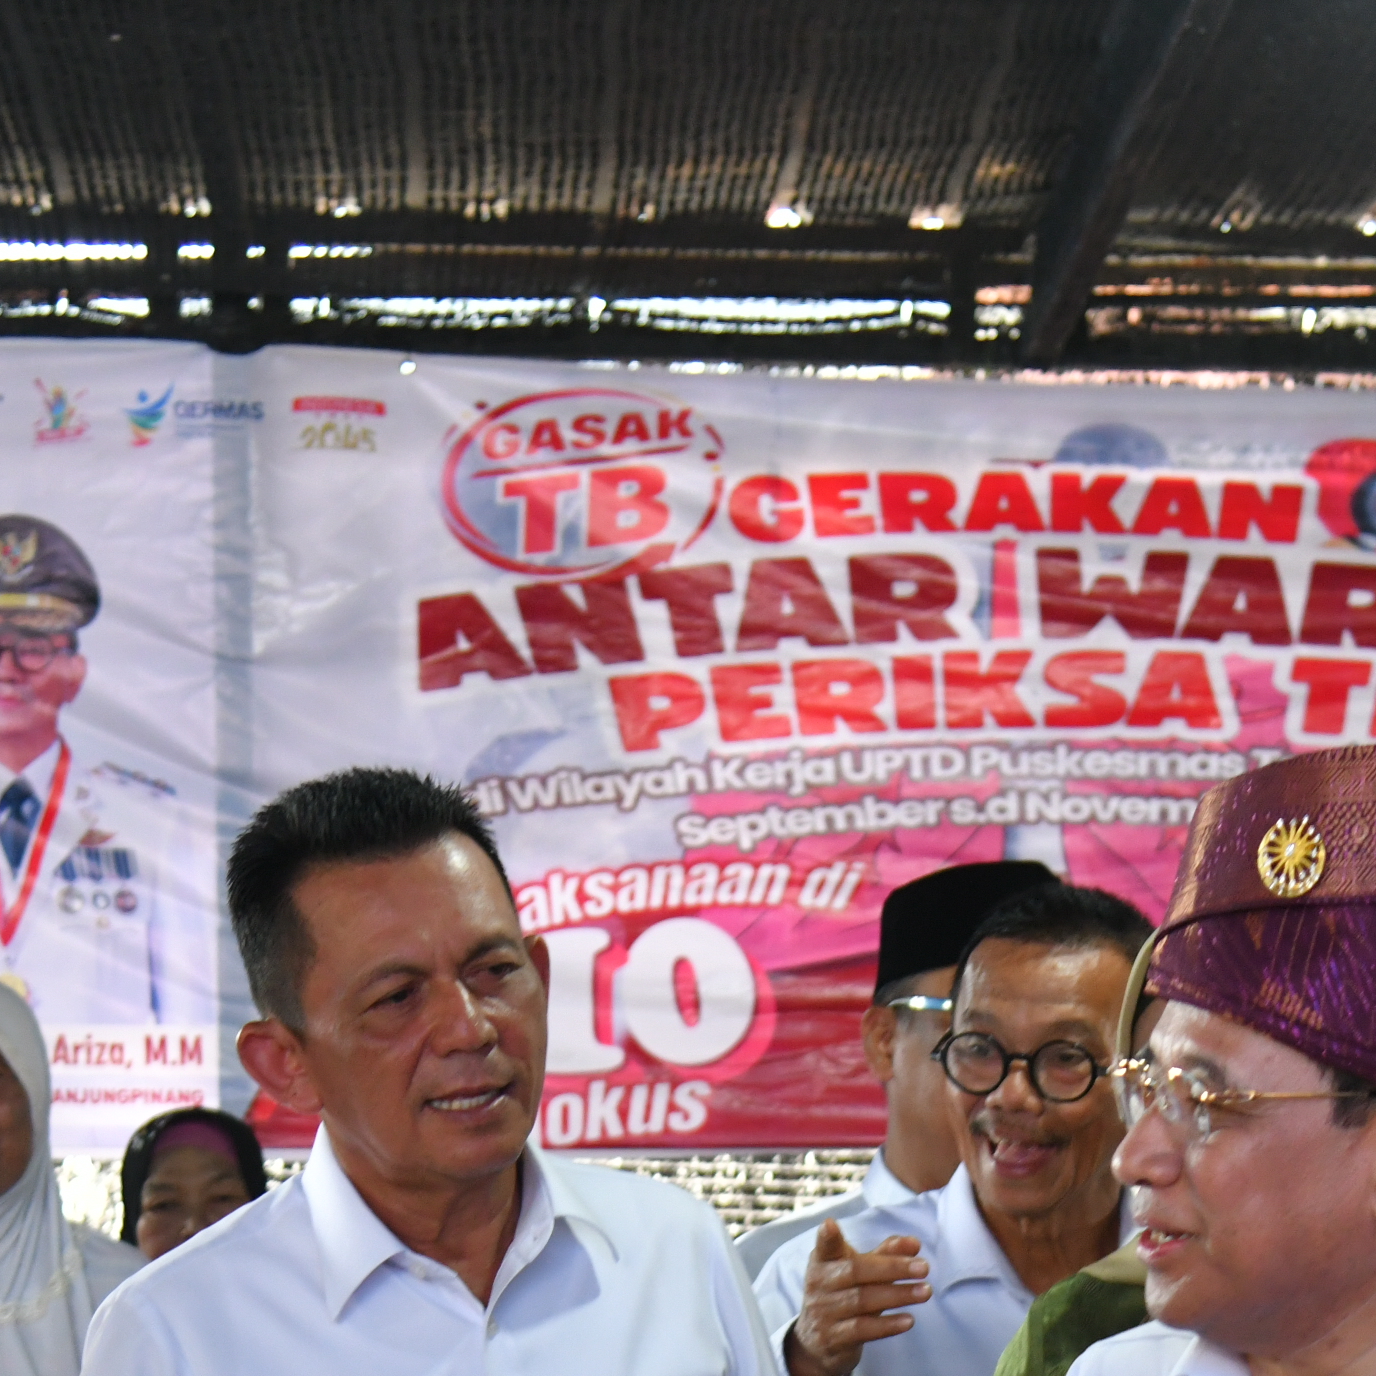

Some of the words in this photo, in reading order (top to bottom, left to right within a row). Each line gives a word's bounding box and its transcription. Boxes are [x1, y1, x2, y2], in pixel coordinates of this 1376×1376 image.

[481, 407, 694, 461] GASAK
[502, 465, 672, 554] TB
[728, 470, 1307, 543] GERAKAN
[418, 552, 962, 691] ANTAR
[607, 648, 1223, 752] PERIKSA
[506, 762, 708, 811] Wilayah
[711, 749, 836, 796] Kerja
[839, 745, 966, 781] UPTD
[971, 745, 1246, 780] Puskesmas
[678, 794, 946, 850] September
[949, 789, 1020, 825] s.d
[1025, 789, 1202, 826] Novem
[517, 862, 791, 930] aksanaan
[797, 861, 866, 910] di
[52, 1033, 133, 1068] Ariza,
[144, 1034, 203, 1066] M.M
[52, 1087, 204, 1106] ANJUNGPINANG
[544, 1079, 712, 1147] okus
